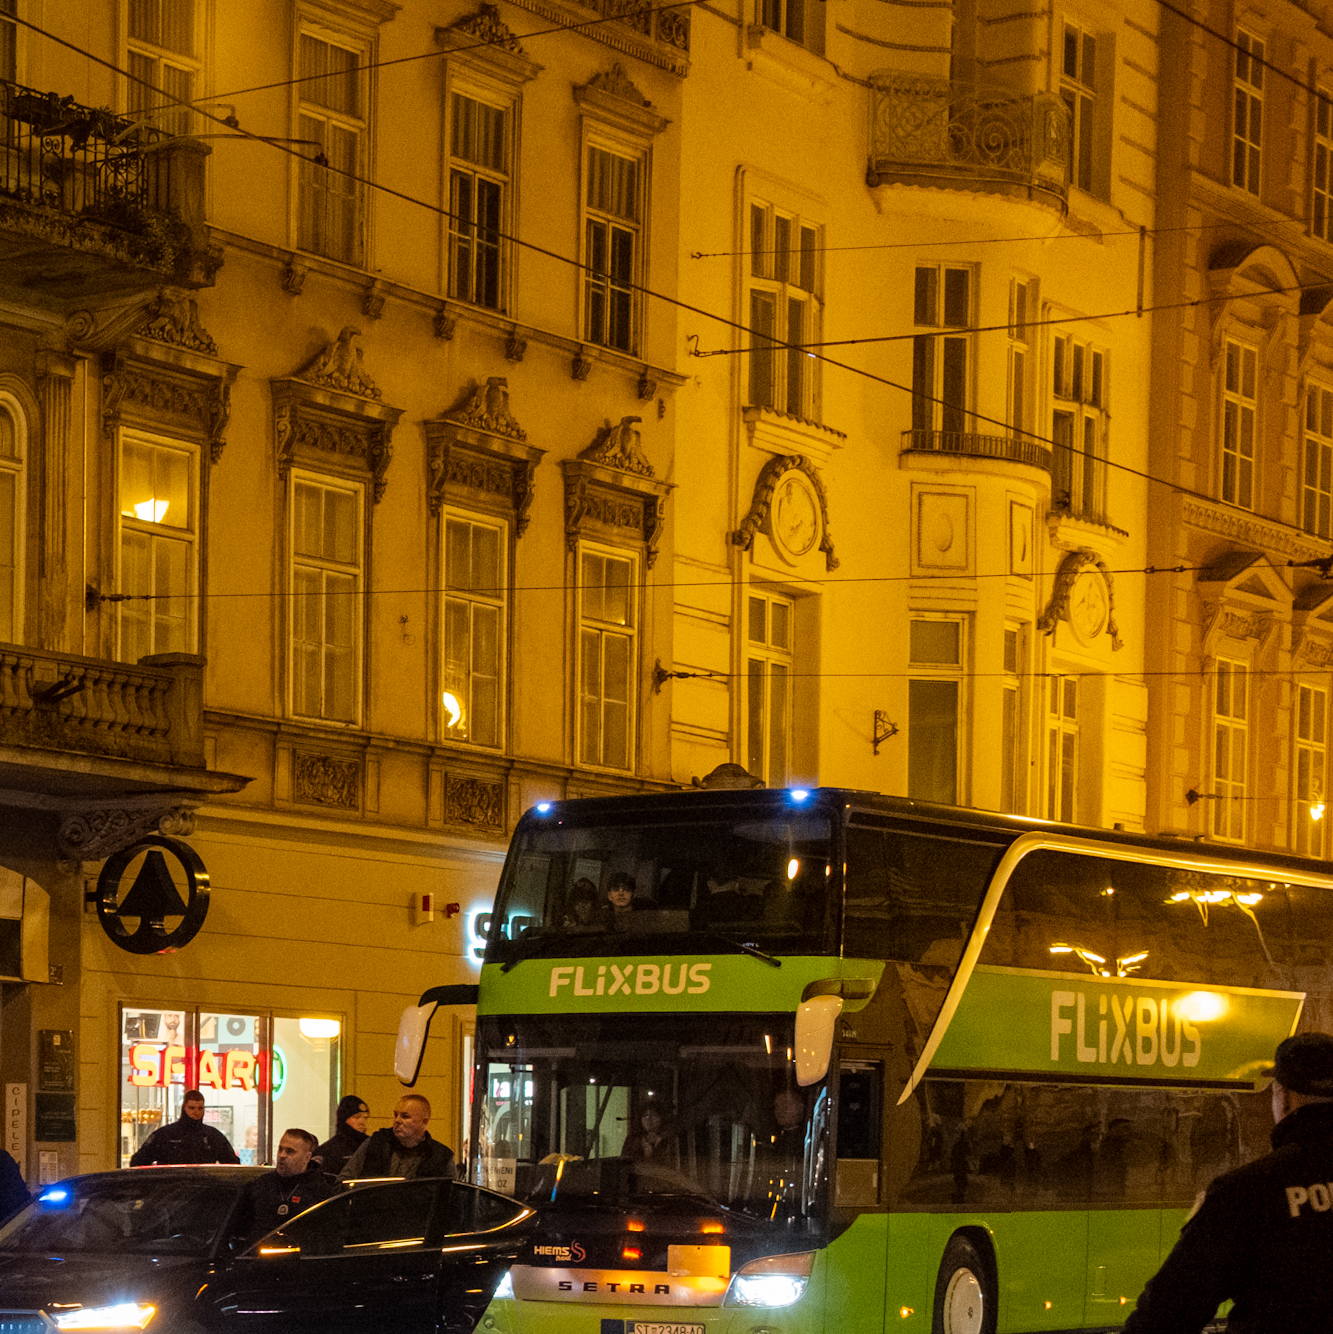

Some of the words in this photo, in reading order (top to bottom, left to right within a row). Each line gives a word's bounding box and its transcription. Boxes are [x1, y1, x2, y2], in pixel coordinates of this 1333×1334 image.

[11, 1086, 20, 1151] CIPELE
[534, 1245, 570, 1256] HIEMS
[558, 1281, 670, 1294] SETRA
